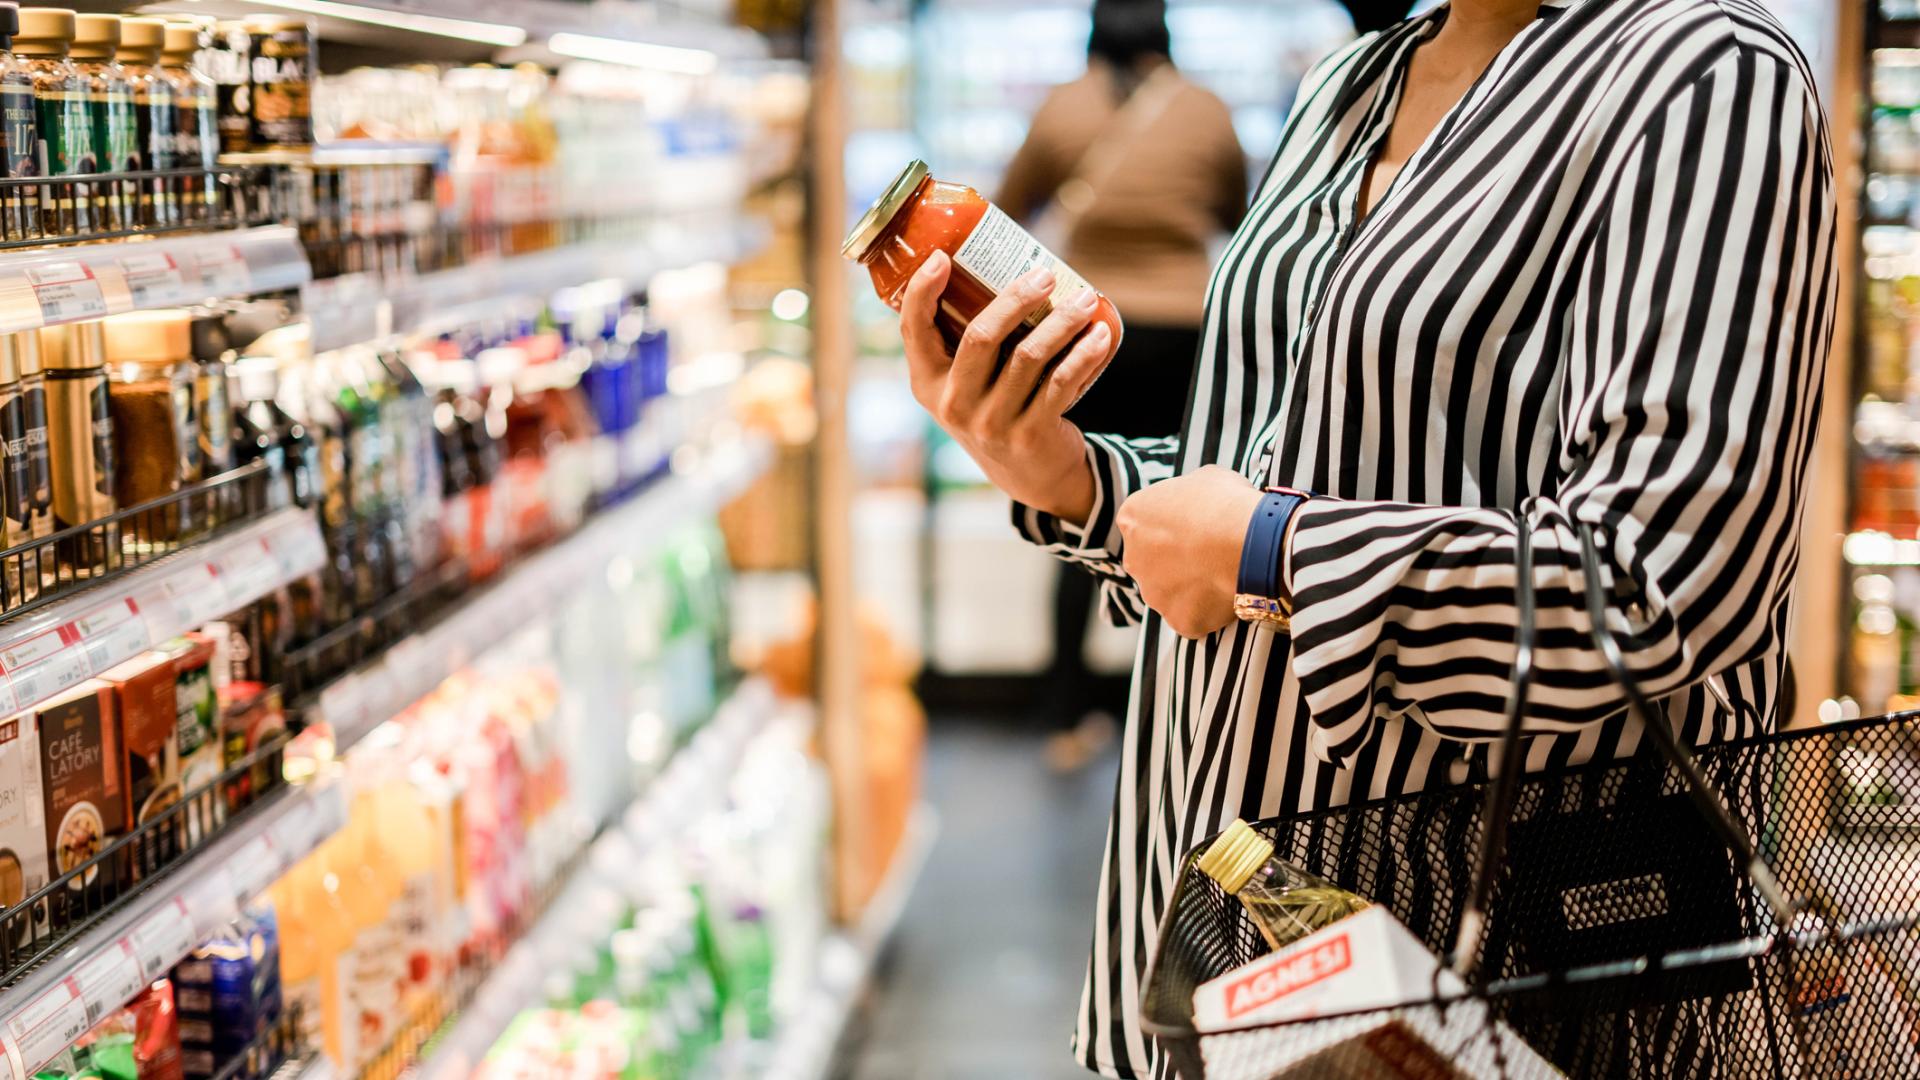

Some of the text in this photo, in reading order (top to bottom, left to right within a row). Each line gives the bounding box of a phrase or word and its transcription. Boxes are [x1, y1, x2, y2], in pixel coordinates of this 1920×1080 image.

[14, 123, 35, 155] 117
[50, 745, 100, 780] LATORY
[1231, 942, 1345, 1012] AGNESI
